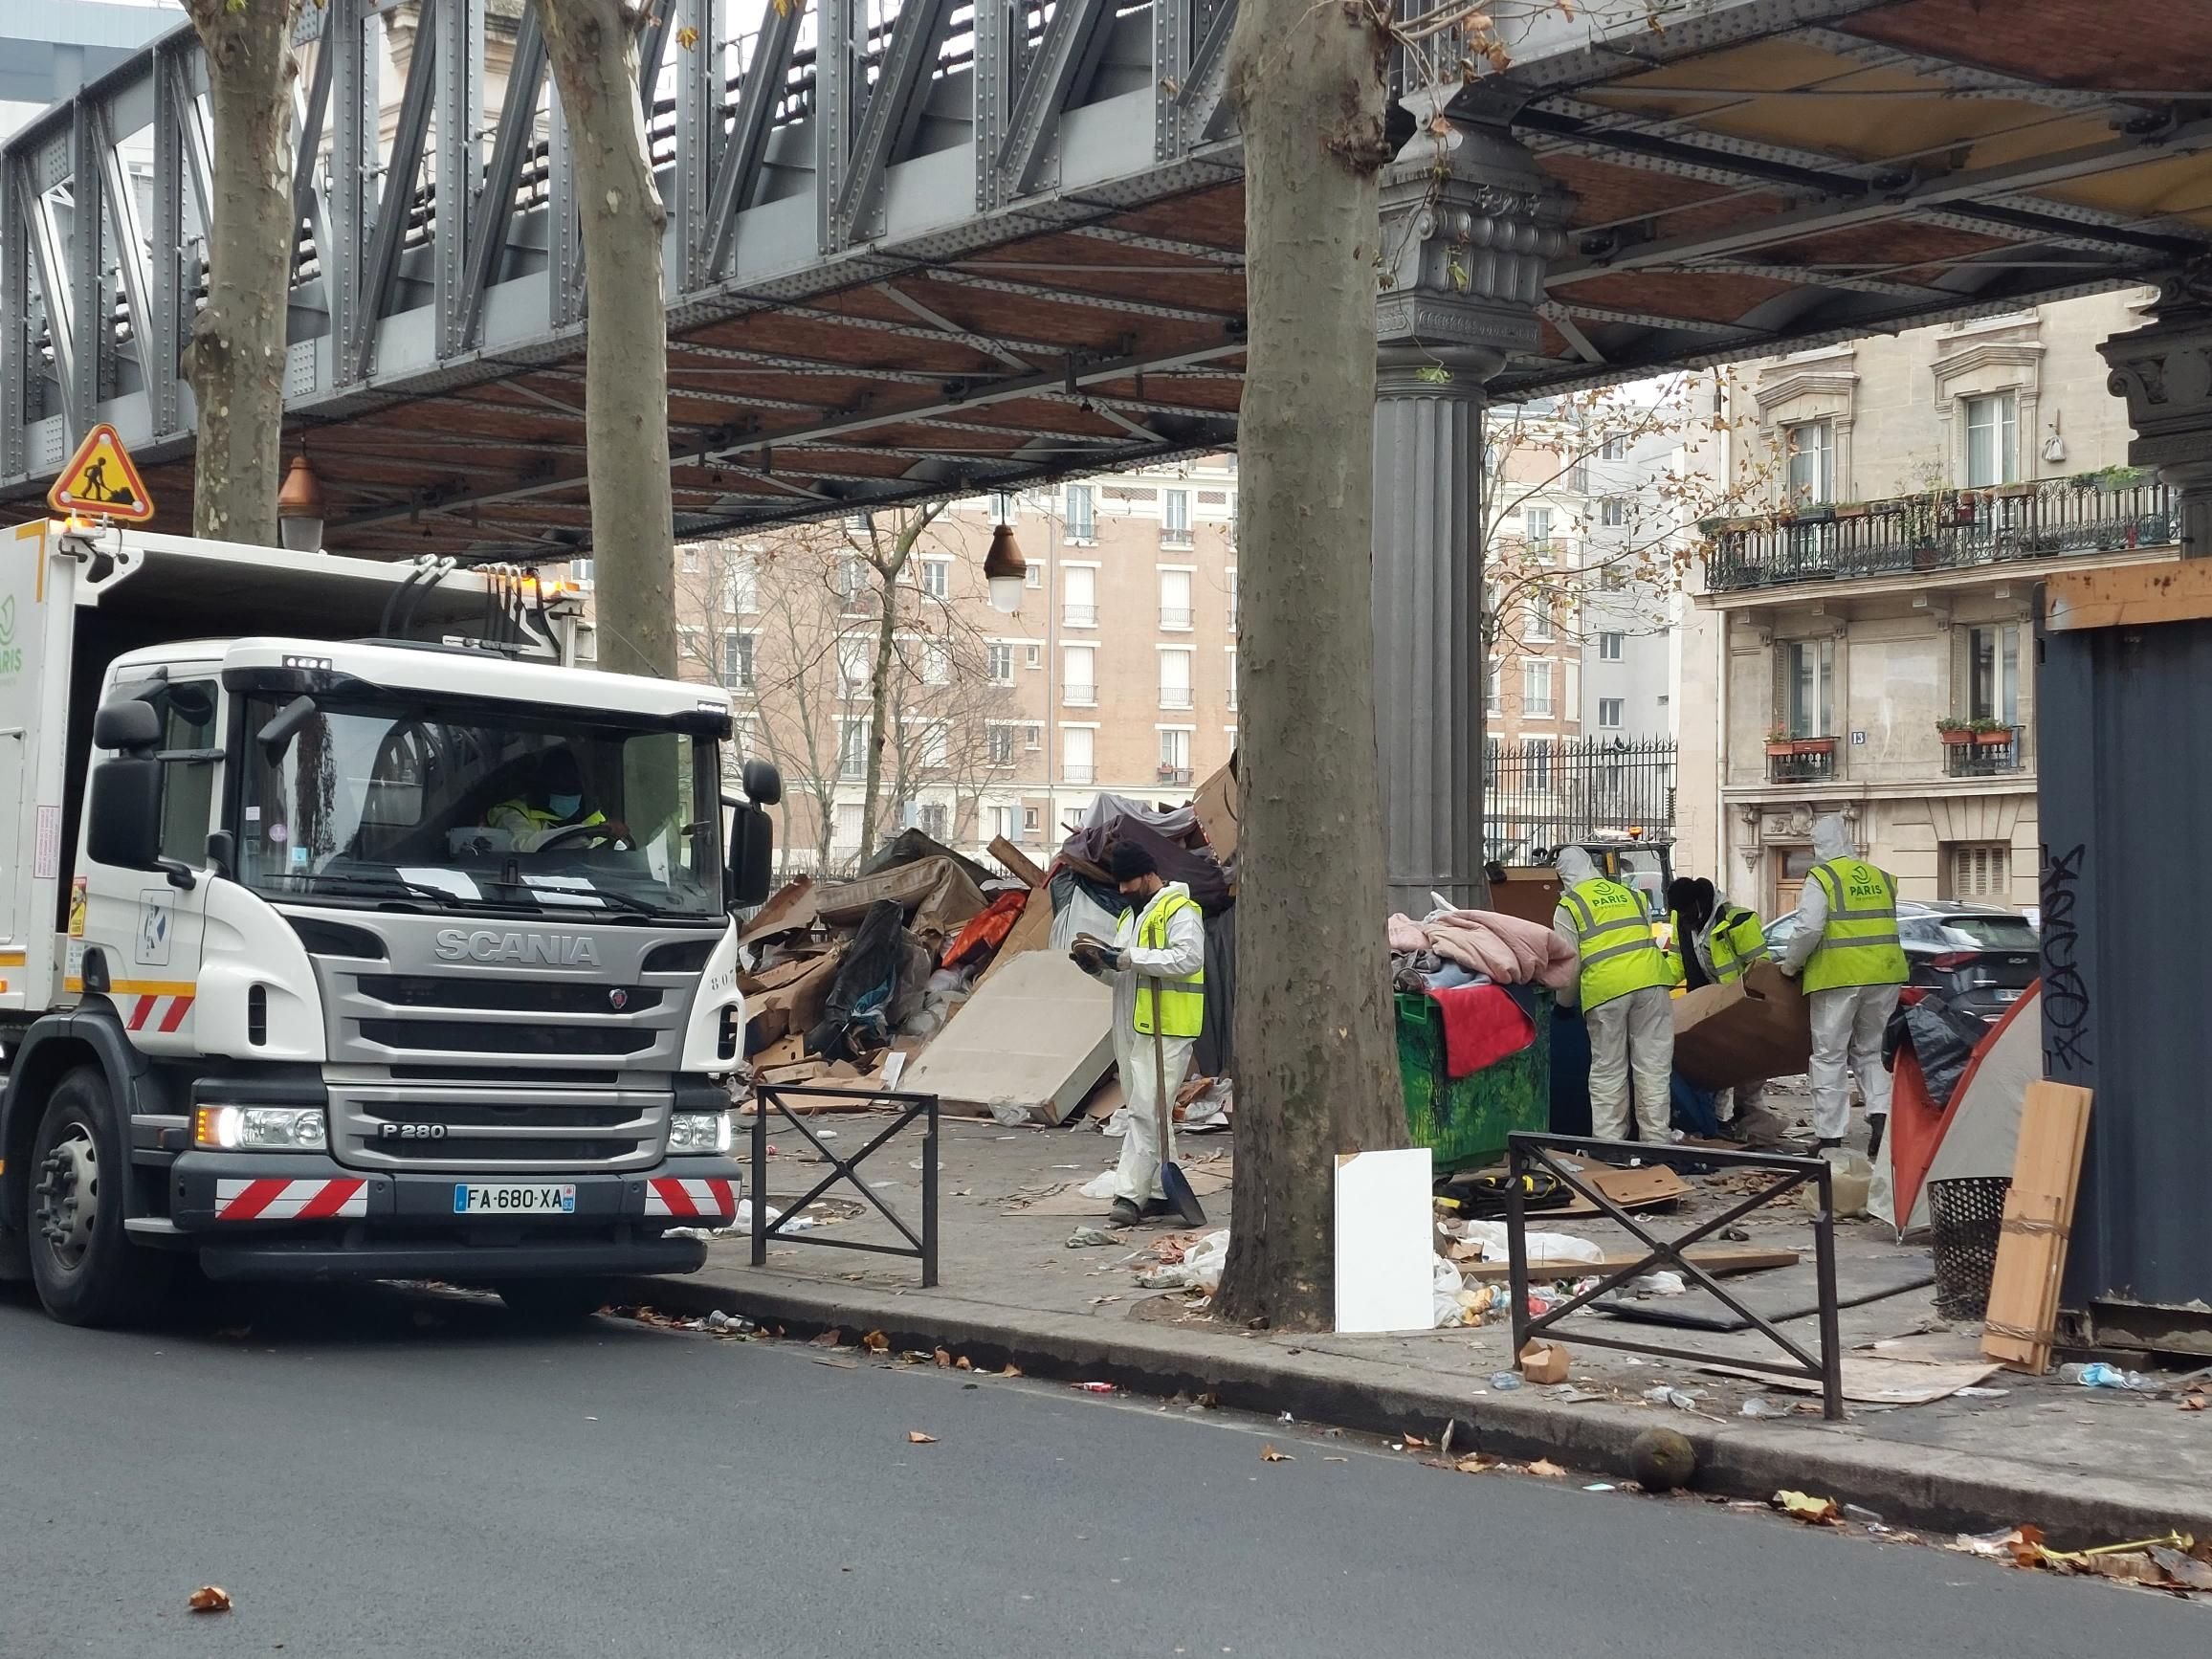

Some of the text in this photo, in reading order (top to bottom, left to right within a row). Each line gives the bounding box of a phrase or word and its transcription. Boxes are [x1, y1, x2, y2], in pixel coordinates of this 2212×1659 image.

[1852, 732, 1865, 744] 13
[1848, 885, 1883, 896] PARIS
[1591, 894, 1628, 907] PARIS
[434, 928, 602, 966] SCANIA
[383, 1124, 445, 1139] P 280
[467, 1188, 563, 1209] FA-680-XA
